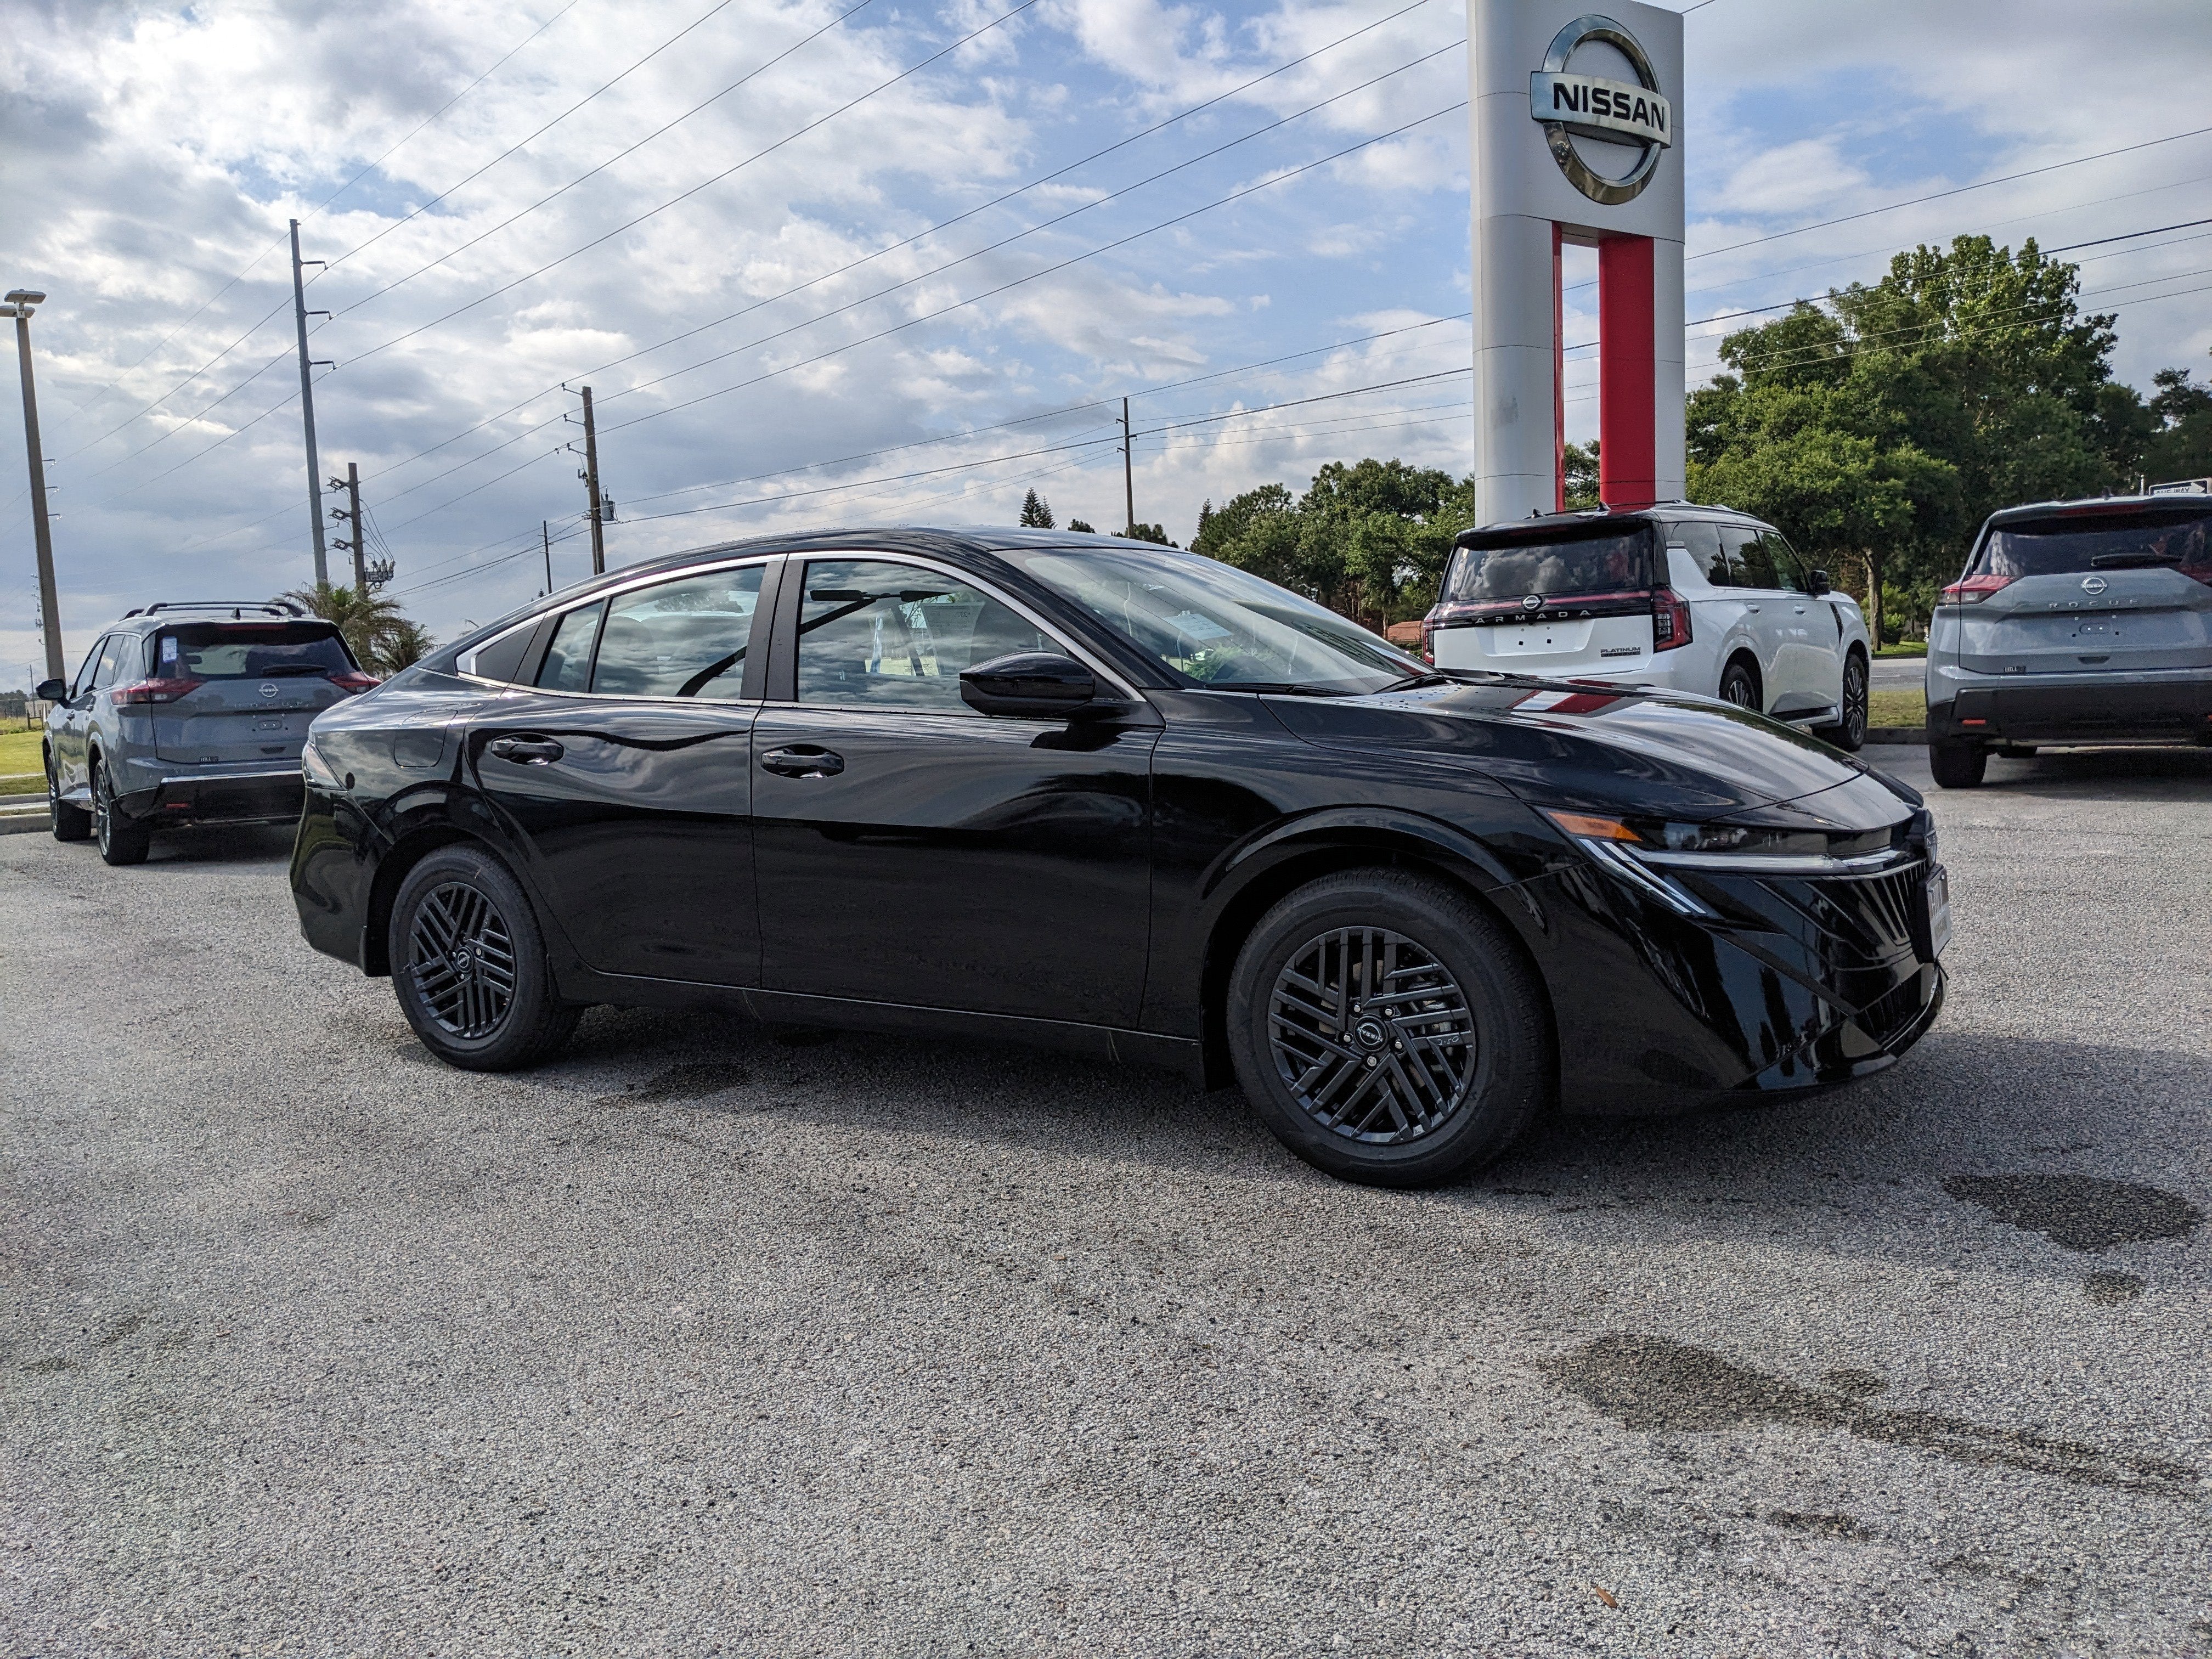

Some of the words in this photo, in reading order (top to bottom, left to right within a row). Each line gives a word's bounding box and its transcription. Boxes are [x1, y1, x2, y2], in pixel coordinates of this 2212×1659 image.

[1553, 82, 1664, 133] NISSAN
[2049, 599, 2138, 610] ROGUE
[1475, 610, 1591, 624] ARMADA
